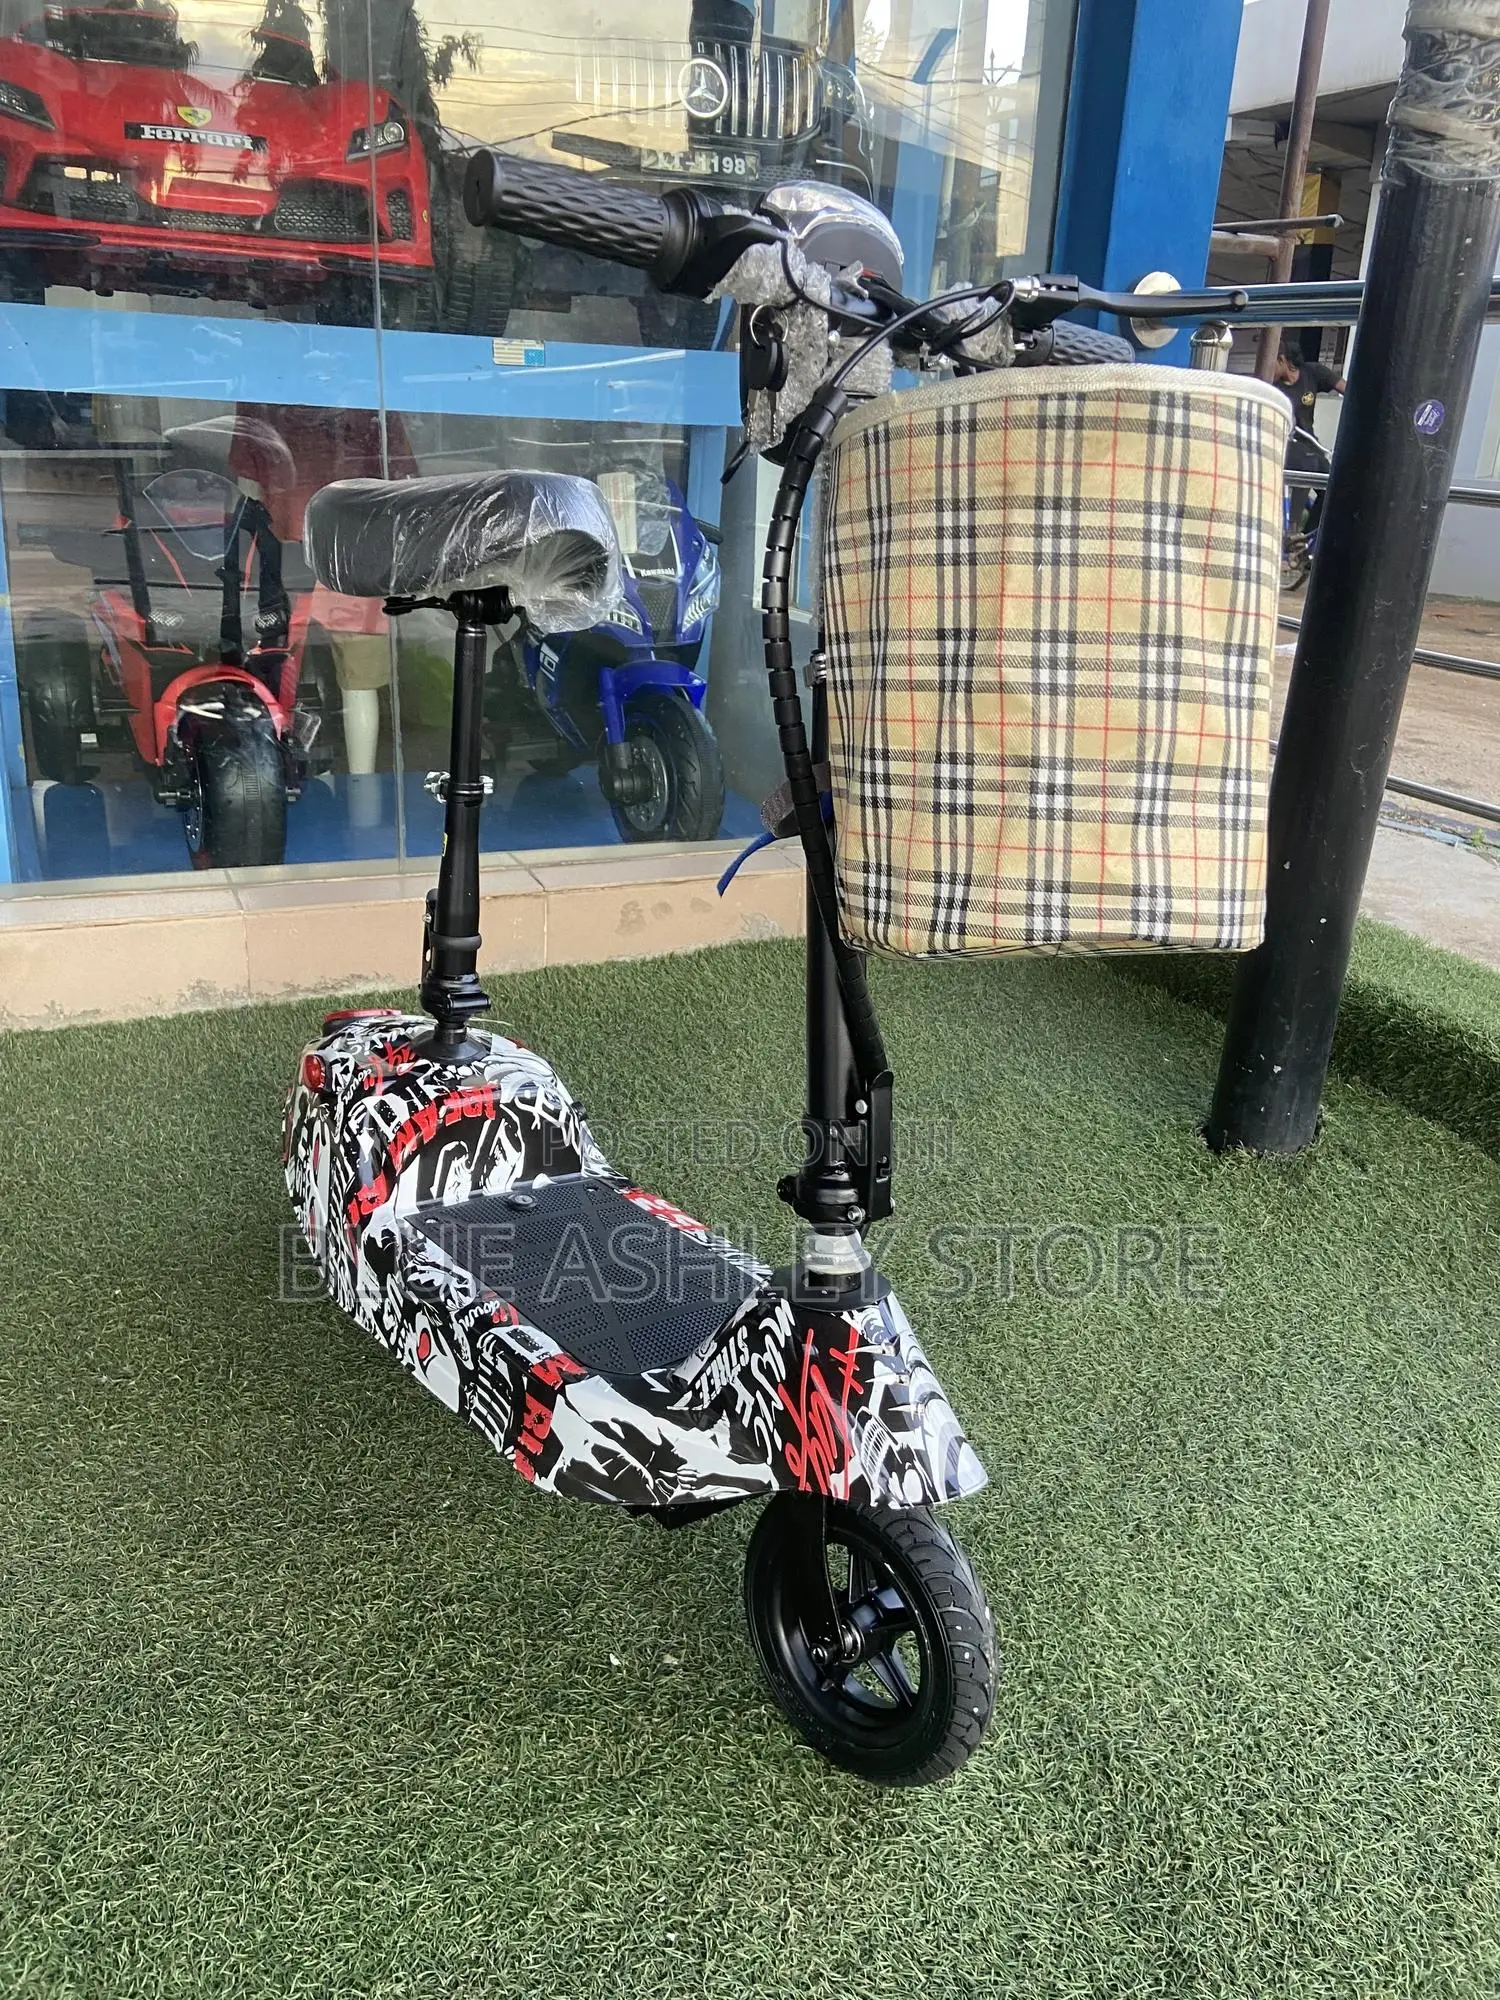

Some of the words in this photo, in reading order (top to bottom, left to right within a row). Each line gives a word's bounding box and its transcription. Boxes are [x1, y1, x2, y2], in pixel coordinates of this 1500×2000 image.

[140, 123, 254, 150] Ferrari
[640, 567, 676, 578] Kawasaki
[459, 1300, 500, 1332] down
